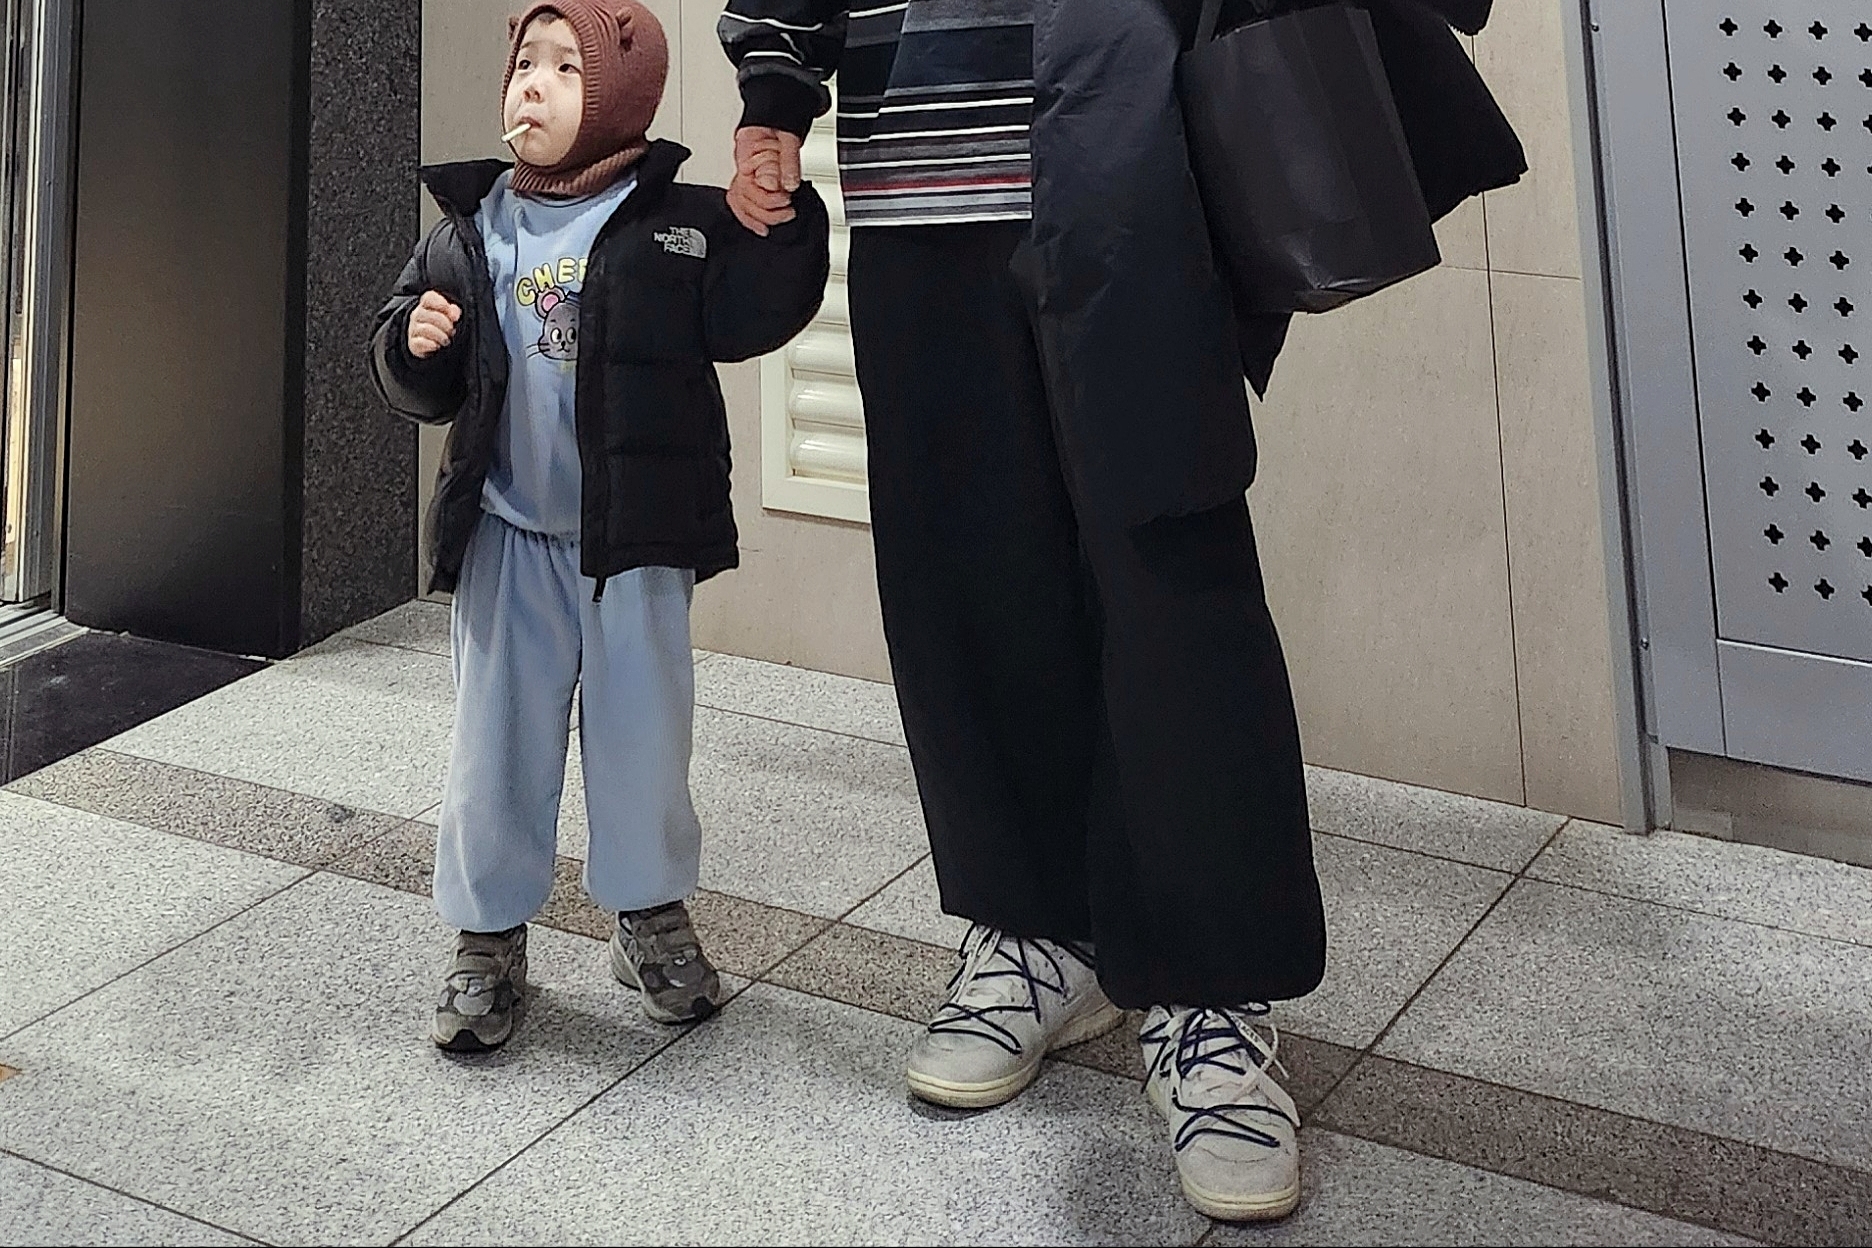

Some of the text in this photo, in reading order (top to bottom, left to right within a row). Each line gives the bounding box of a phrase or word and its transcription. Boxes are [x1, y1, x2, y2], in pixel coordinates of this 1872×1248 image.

[669, 226, 690, 237] THE
[654, 232, 691, 247] NORTH
[664, 243, 691, 254] FACE
